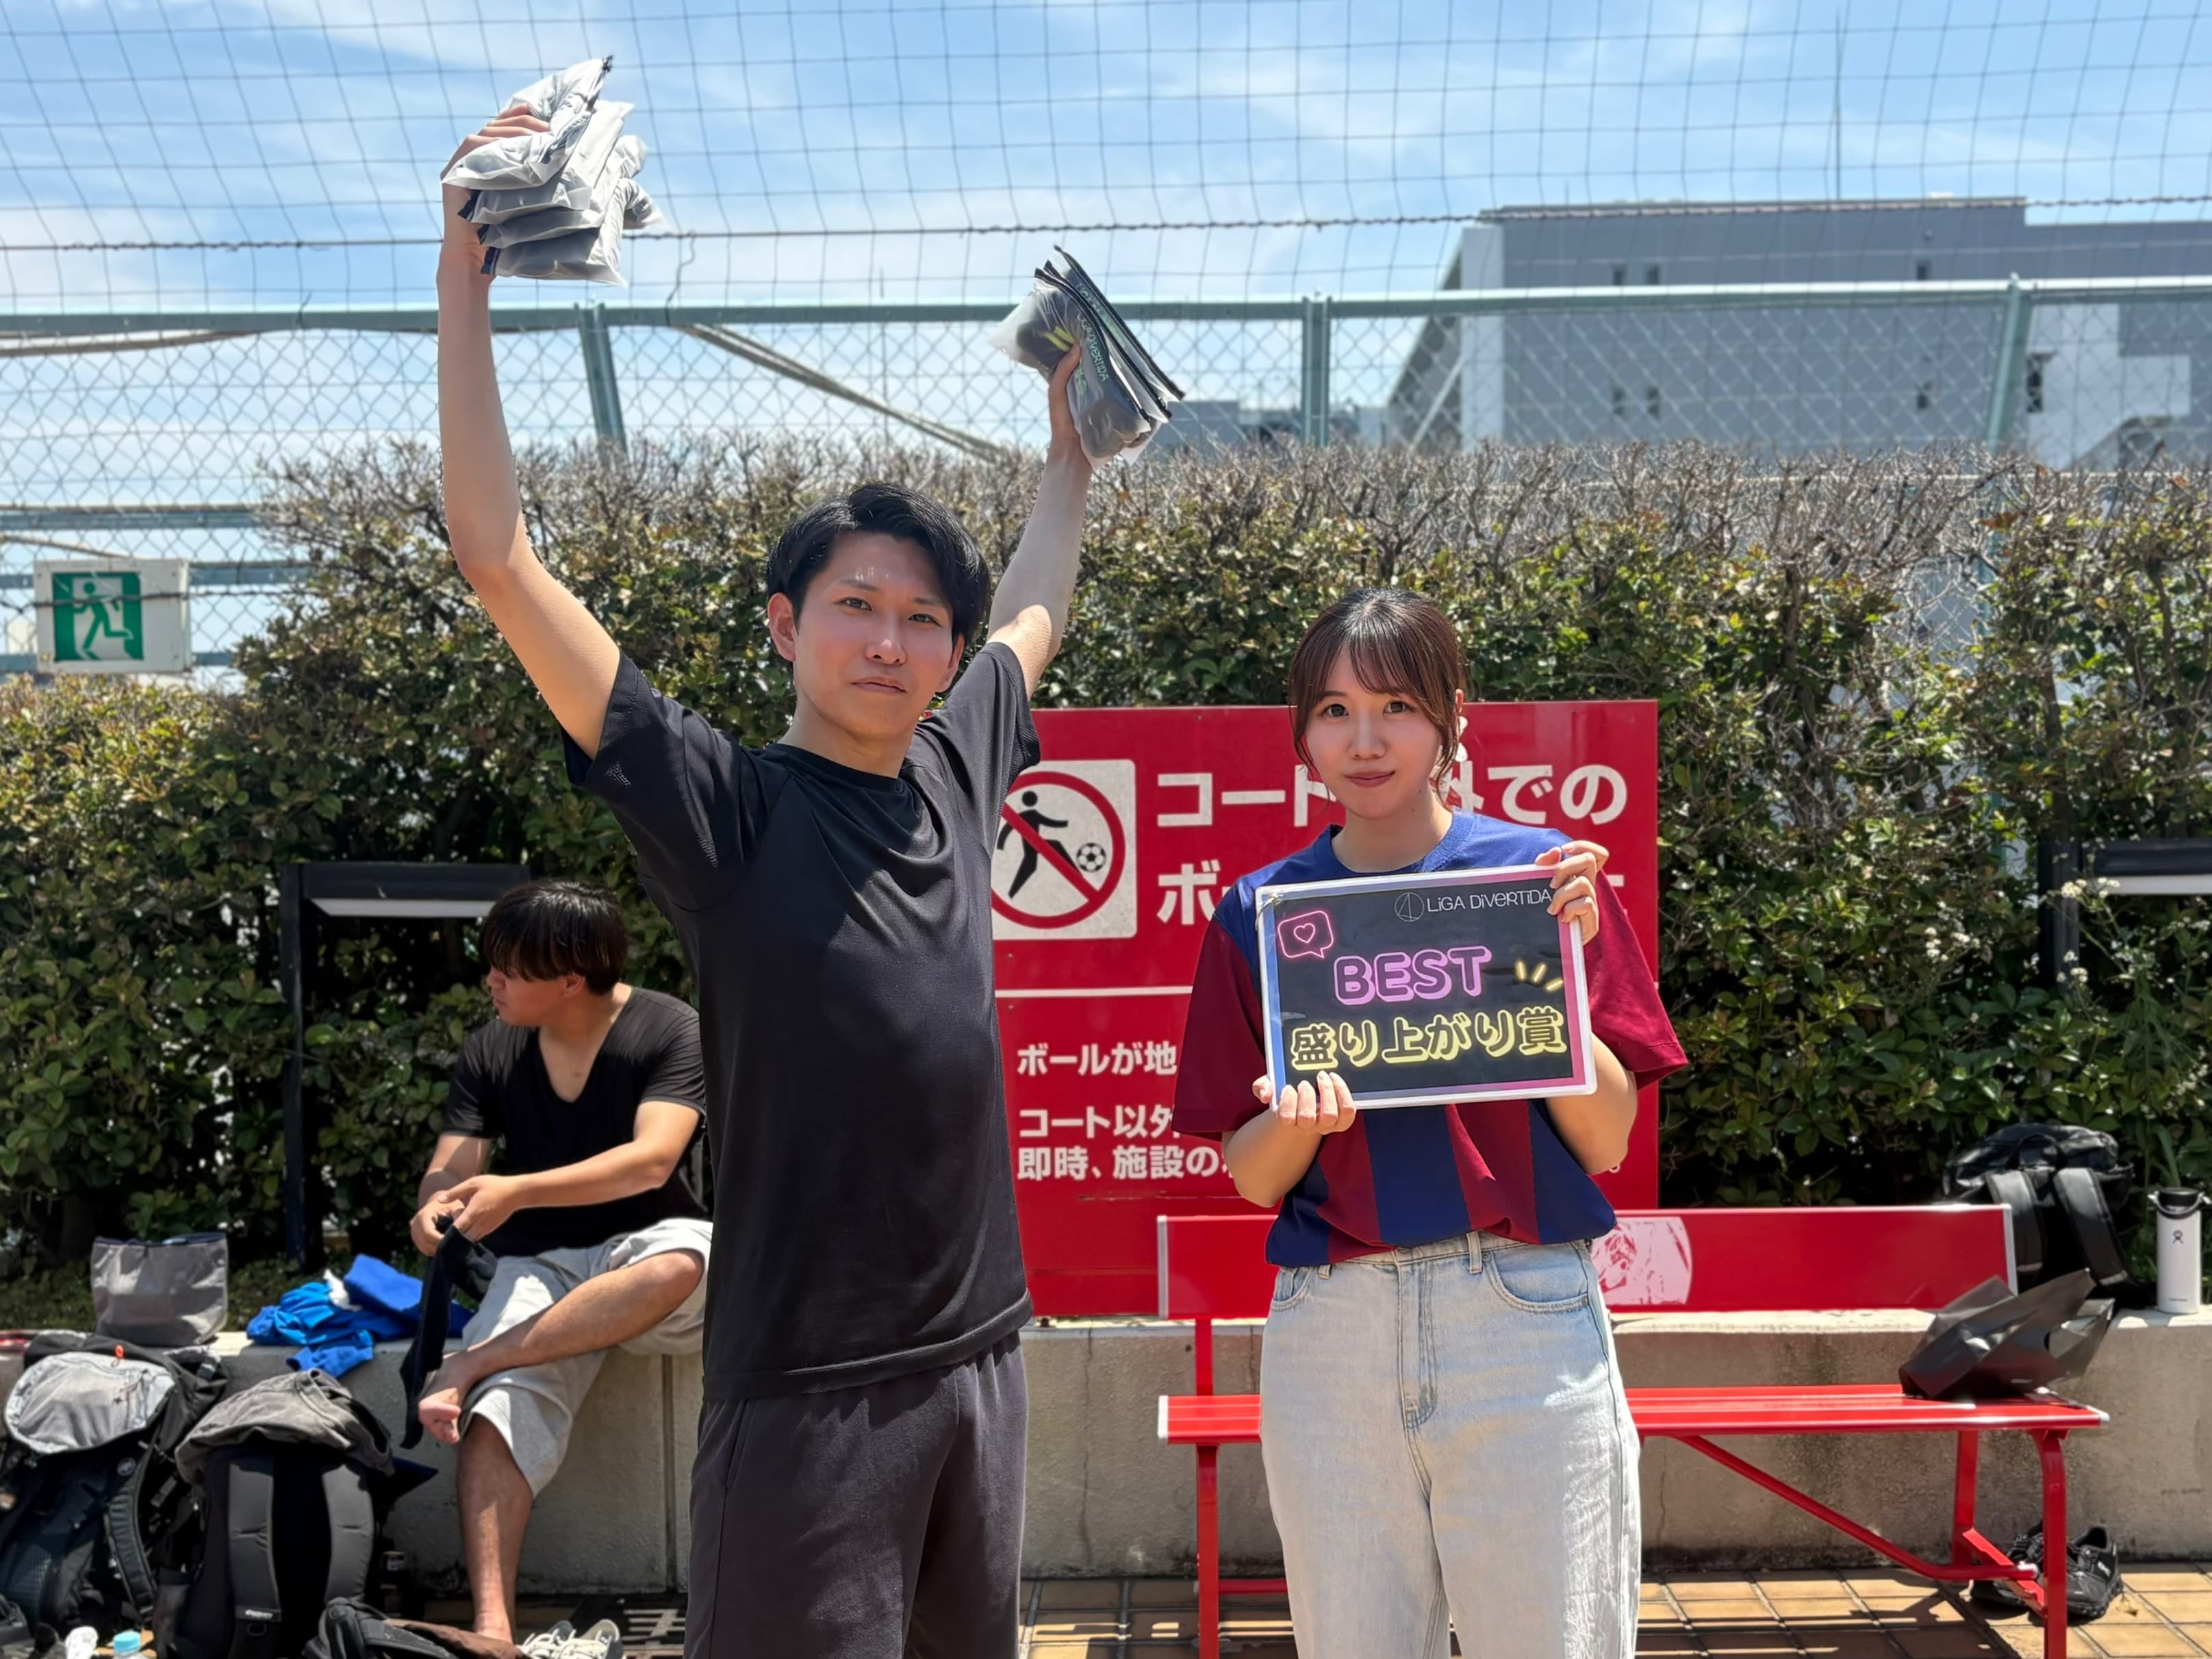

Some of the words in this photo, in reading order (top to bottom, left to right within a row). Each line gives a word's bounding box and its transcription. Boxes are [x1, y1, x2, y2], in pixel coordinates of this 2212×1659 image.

[1157, 761, 1627, 827] コート外での
[1334, 946, 1492, 1006] BEST
[1017, 1041, 1178, 1076] ボールが地
[1291, 1006, 1567, 1071] 盛り上がり賞
[1017, 1145, 1232, 1181] 即時、施設の
